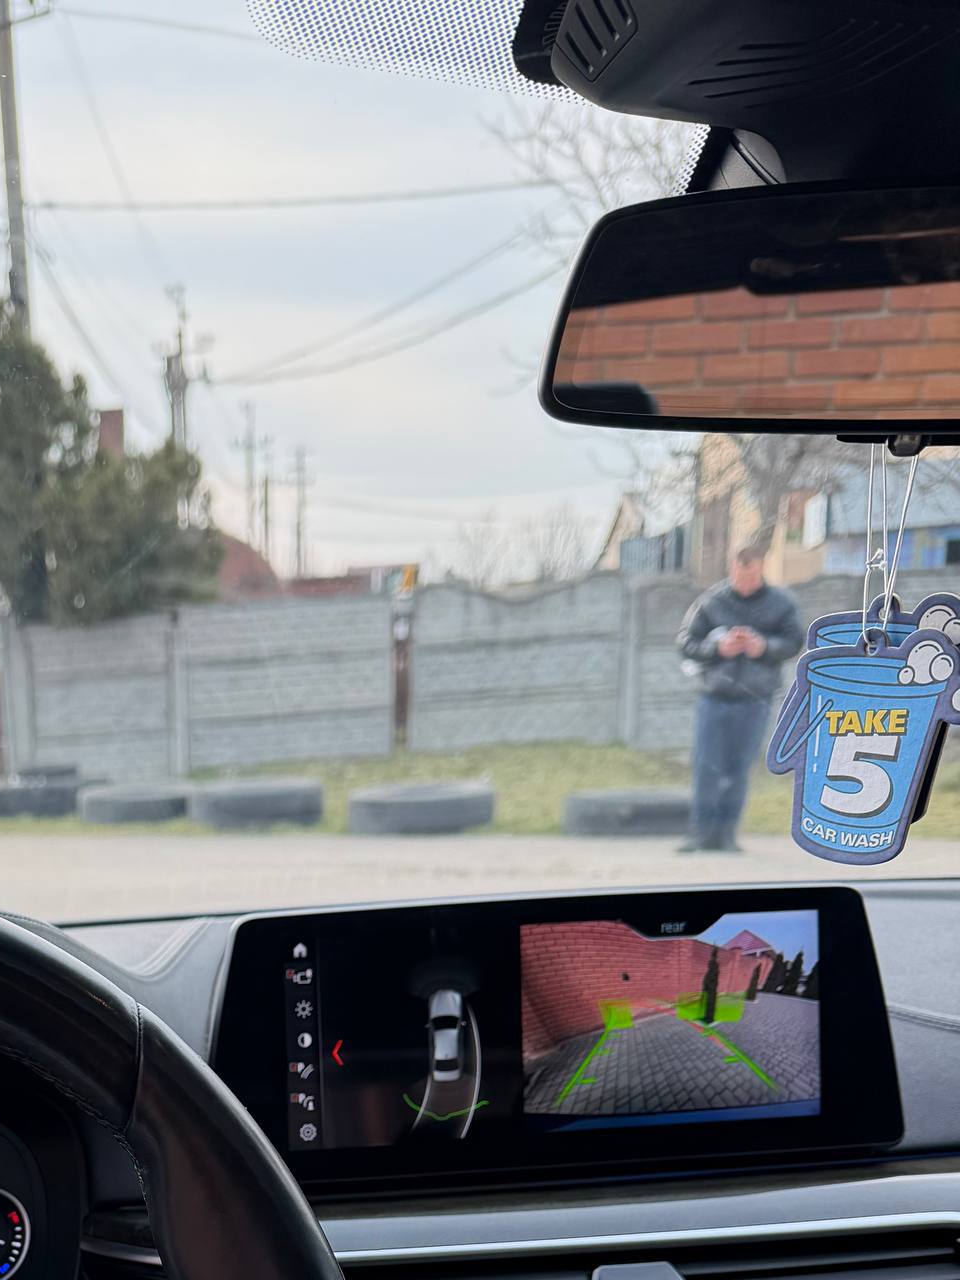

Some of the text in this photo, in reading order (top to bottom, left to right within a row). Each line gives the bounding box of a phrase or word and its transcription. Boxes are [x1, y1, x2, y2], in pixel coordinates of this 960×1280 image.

[826, 709, 908, 735] TAKE
[820, 733, 899, 816] 5
[801, 817, 894, 847] CAR WASH
[661, 921, 687, 934] rear
